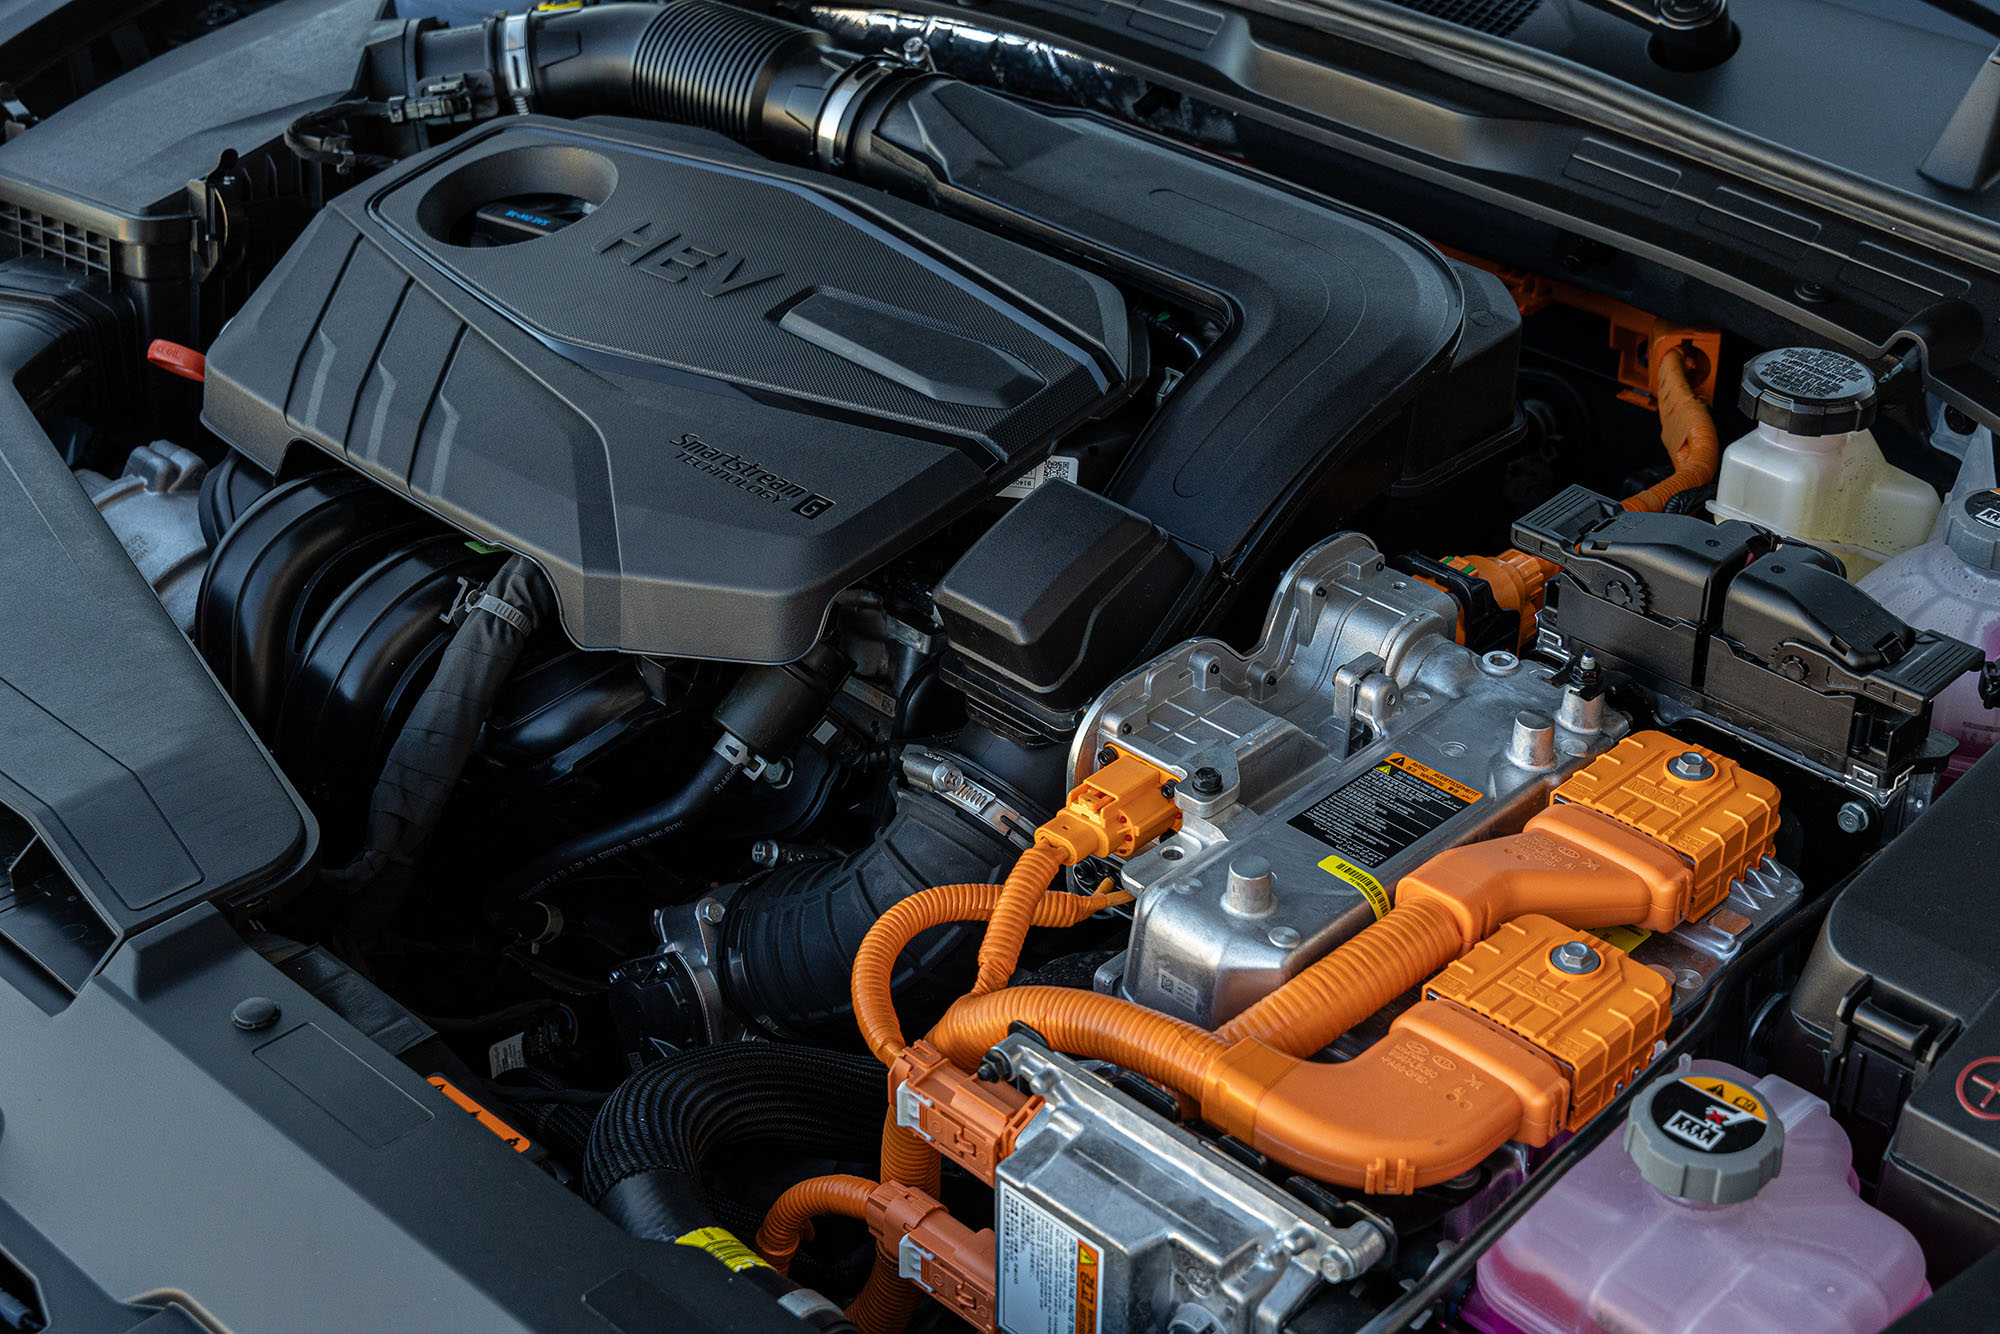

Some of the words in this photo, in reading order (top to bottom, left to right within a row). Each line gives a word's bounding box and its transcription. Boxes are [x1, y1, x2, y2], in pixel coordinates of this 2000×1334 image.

[592, 218, 784, 298] HEV
[669, 432, 808, 498] Smartstream
[675, 450, 789, 504] TECHNOLOGY
[1409, 762, 1429, 772] AVISO
[1431, 772, 1479, 797] AVERTISSEMENT
[1419, 772, 1446, 786] WARNING
[1630, 778, 1690, 812] MOTOR
[1505, 974, 1564, 1010] HSG
[1080, 1271, 1095, 1304] 경고
